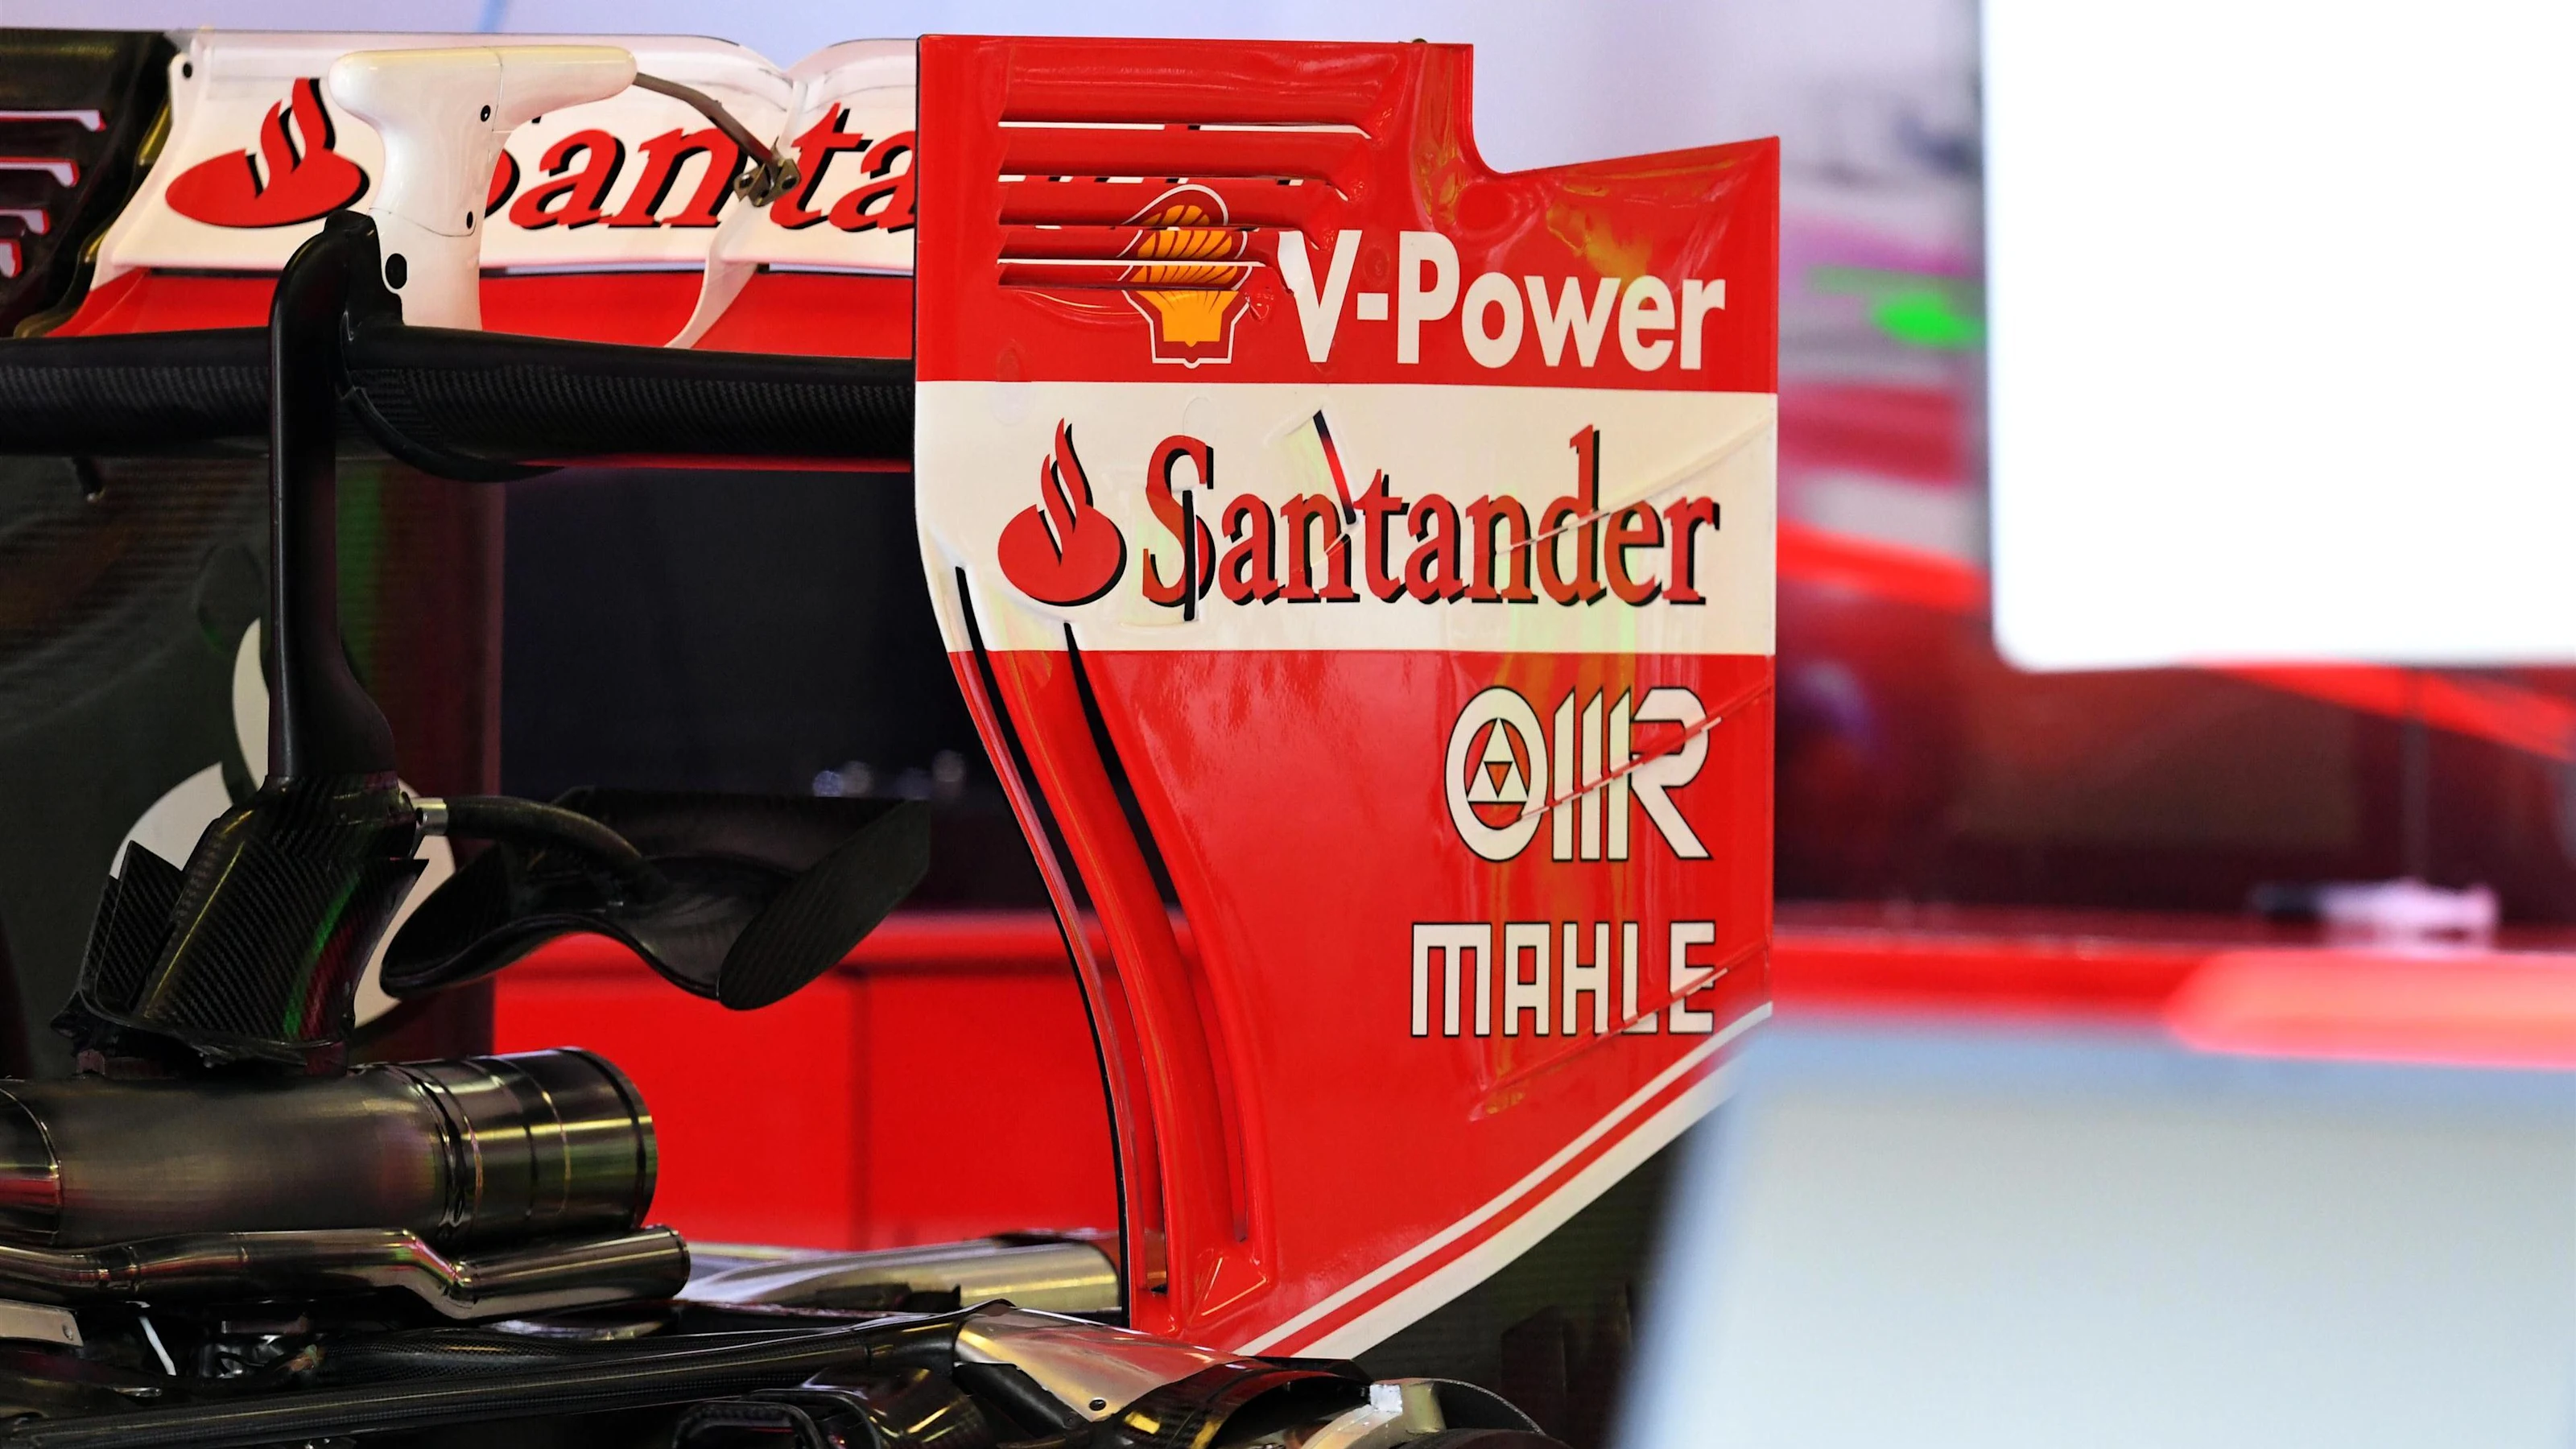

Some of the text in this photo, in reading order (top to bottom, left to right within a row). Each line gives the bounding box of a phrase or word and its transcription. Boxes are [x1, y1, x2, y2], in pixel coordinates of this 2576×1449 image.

[1278, 229, 1726, 371] V-Power
[1142, 425, 1720, 609] Santander
[1411, 922, 1715, 1038] MAHLE
